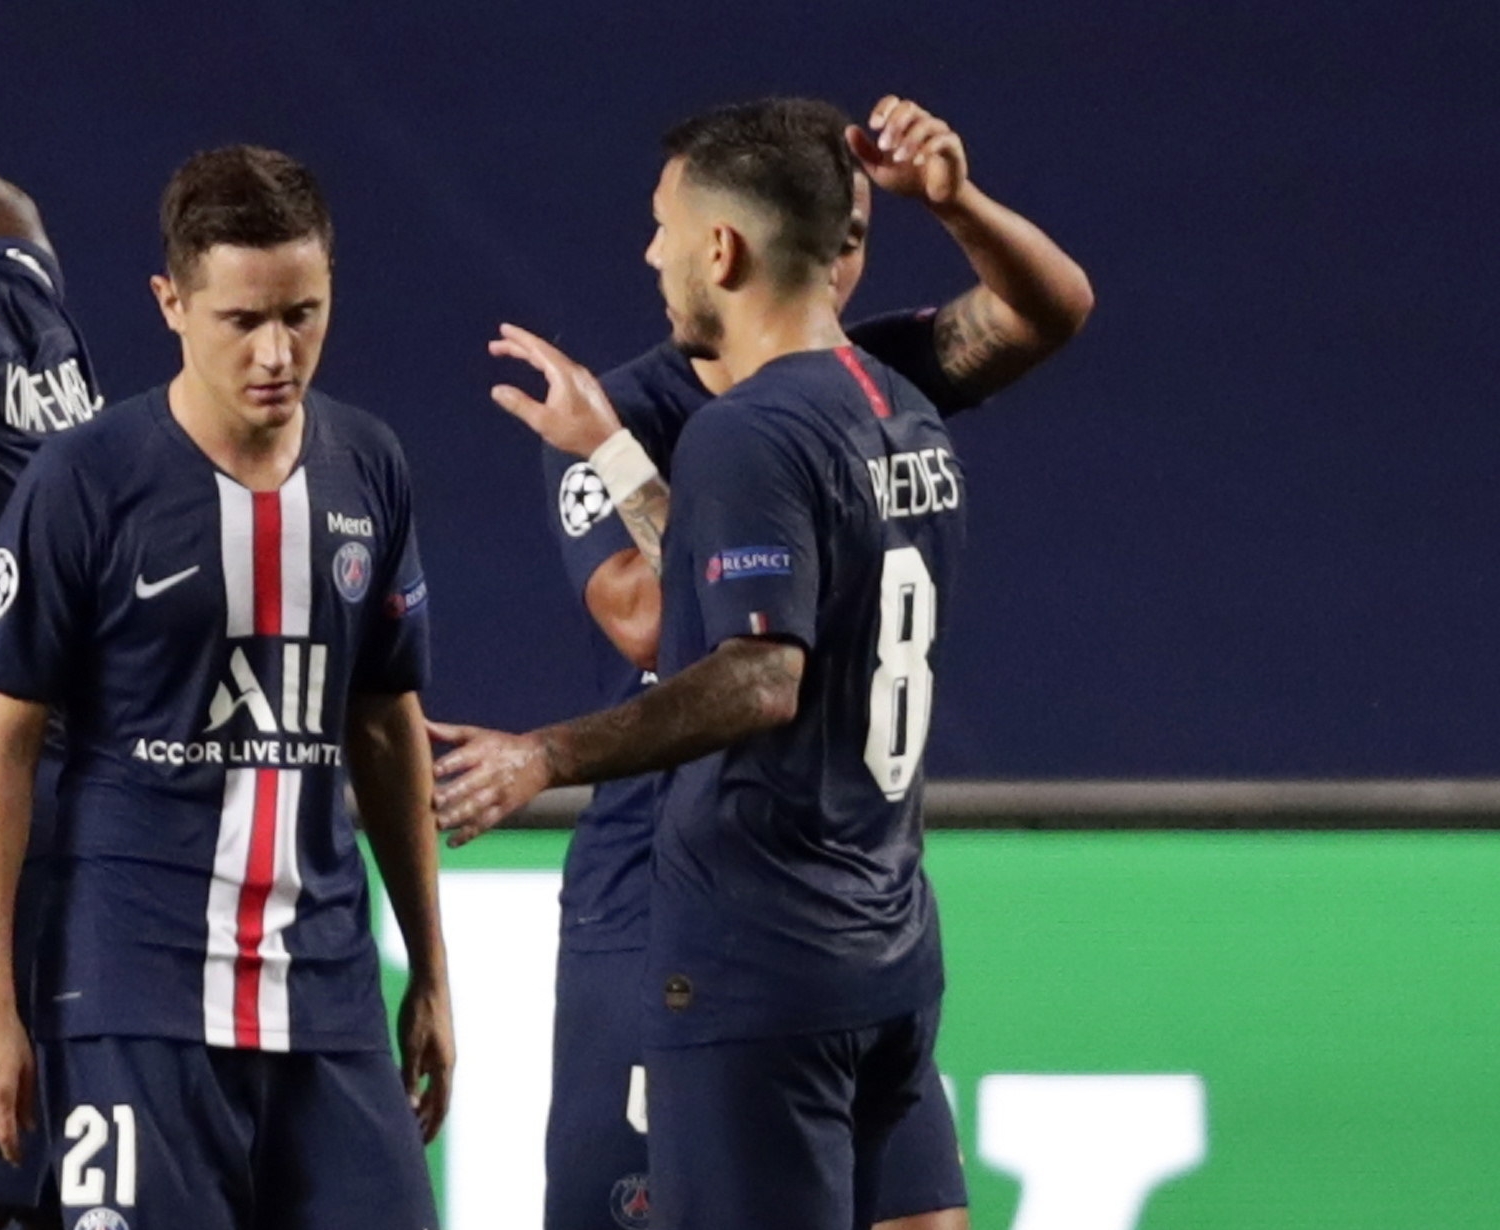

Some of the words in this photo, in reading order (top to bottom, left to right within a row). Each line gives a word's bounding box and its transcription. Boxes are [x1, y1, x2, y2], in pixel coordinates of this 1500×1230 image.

[722, 553, 791, 571] RESPECT
[864, 546, 937, 801] 8
[132, 738, 224, 765] ACCOR
[229, 739, 281, 764] LIVE
[61, 1104, 136, 1208] 21
